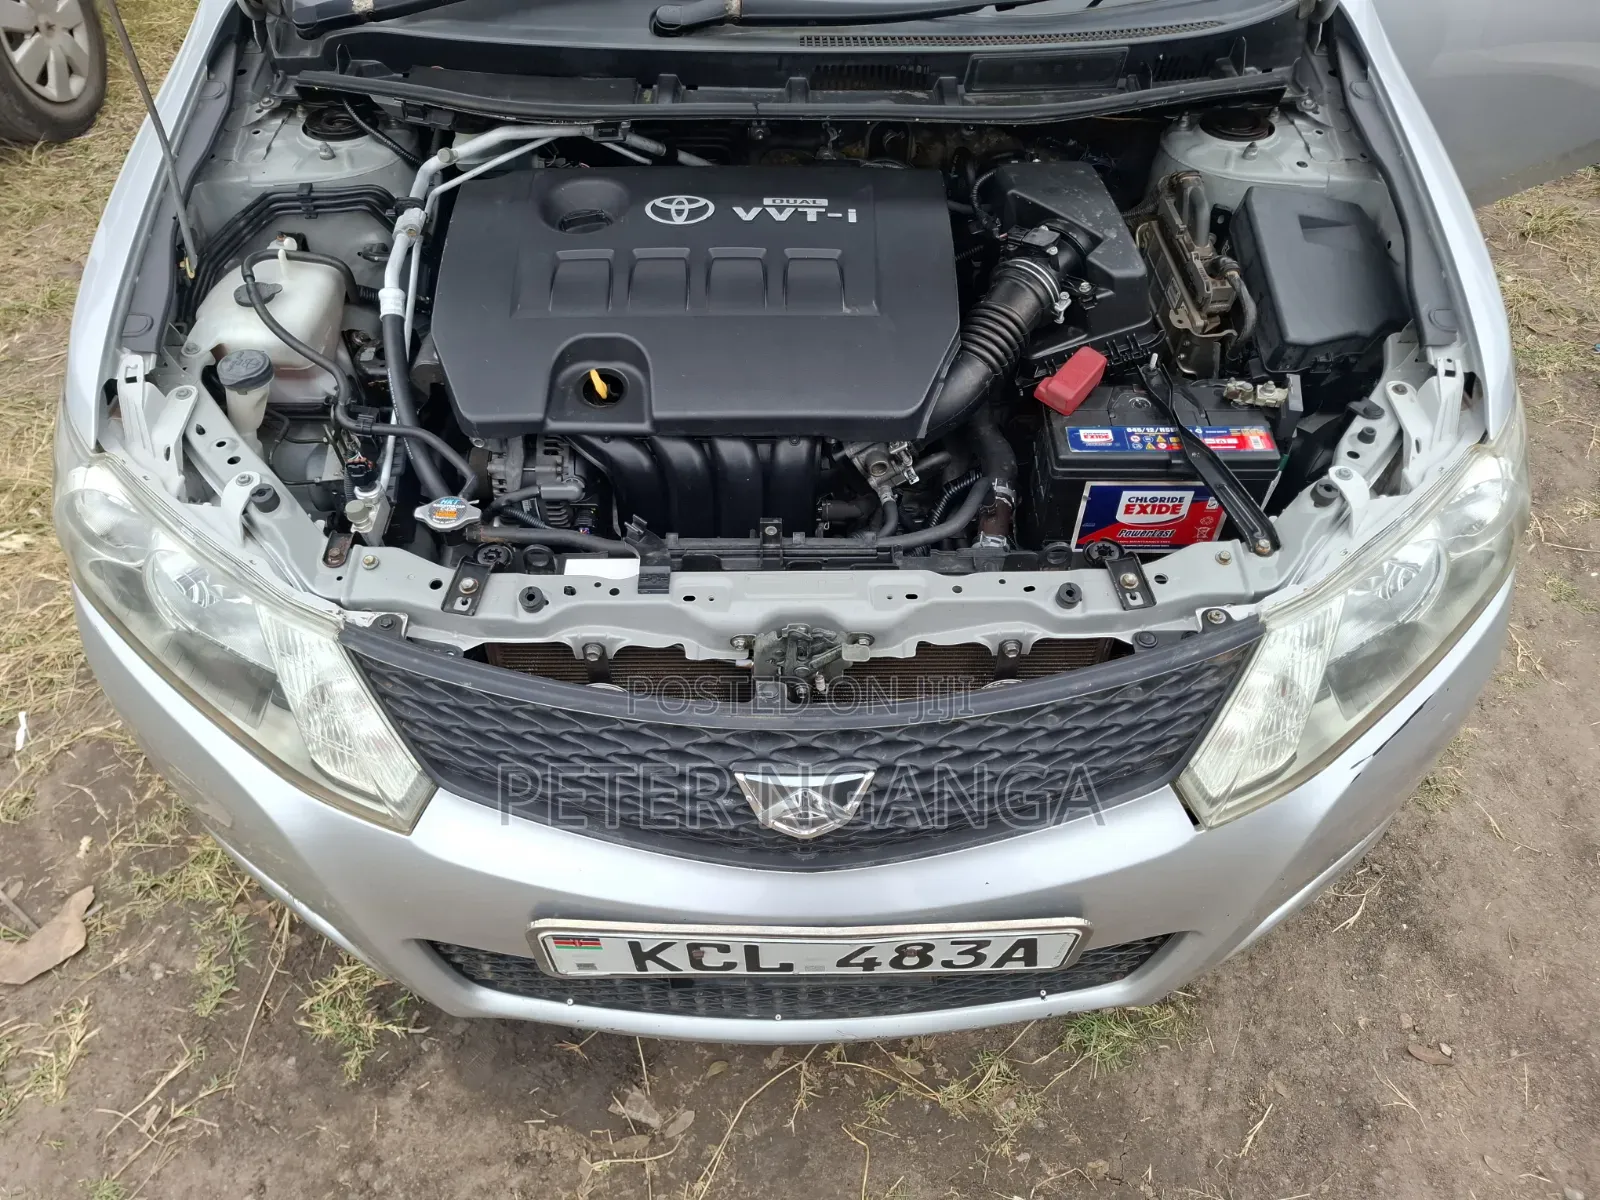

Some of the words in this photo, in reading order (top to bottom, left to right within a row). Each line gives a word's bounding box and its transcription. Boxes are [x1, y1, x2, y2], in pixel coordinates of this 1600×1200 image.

[732, 206, 857, 223] VVT-i
[1123, 504, 1182, 515] EXIDE
[627, 940, 794, 973] KCL
[835, 938, 1038, 972] 483A
